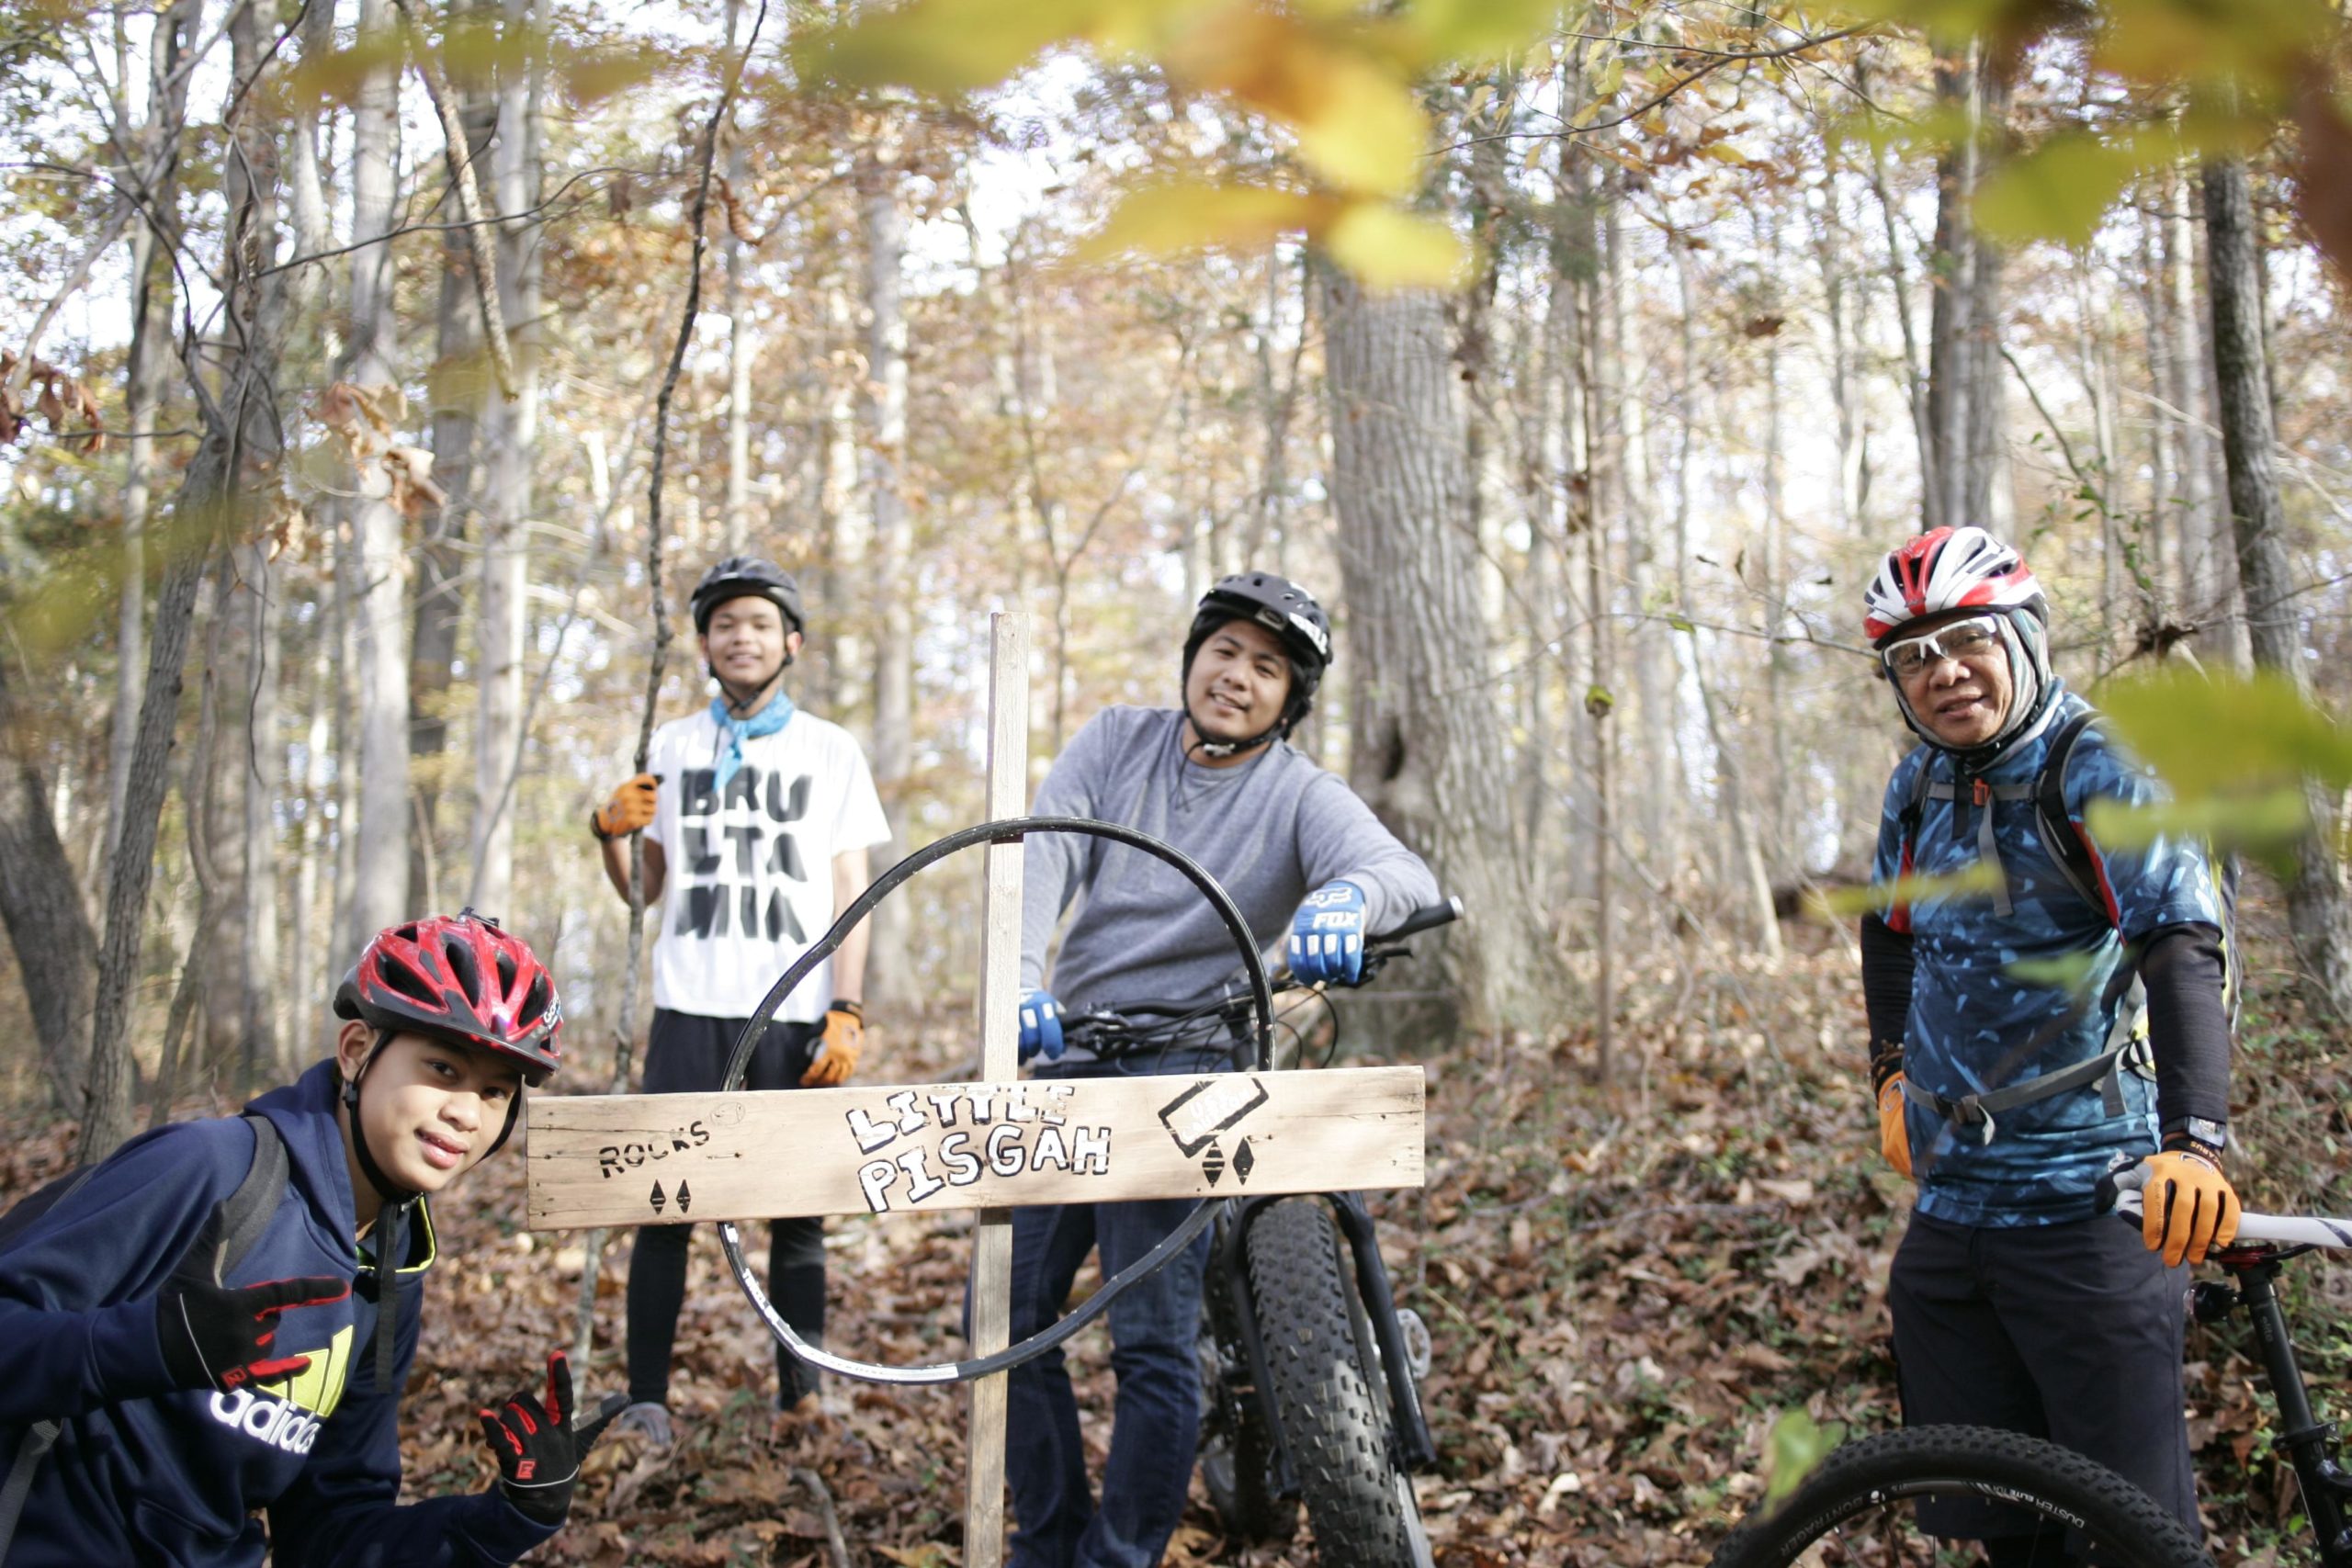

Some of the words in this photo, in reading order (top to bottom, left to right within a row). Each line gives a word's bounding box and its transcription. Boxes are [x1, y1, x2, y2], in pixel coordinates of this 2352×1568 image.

[1312, 911, 1359, 930] FOX
[599, 1120, 710, 1179] ROCKS
[845, 1085, 1075, 1156] LITTLE
[857, 1123, 1112, 1213] PISGAH
[209, 1387, 321, 1454] adidas
[1780, 1495, 1864, 1558] BONTRAGER
[2035, 1498, 2085, 1529] DUSTER
